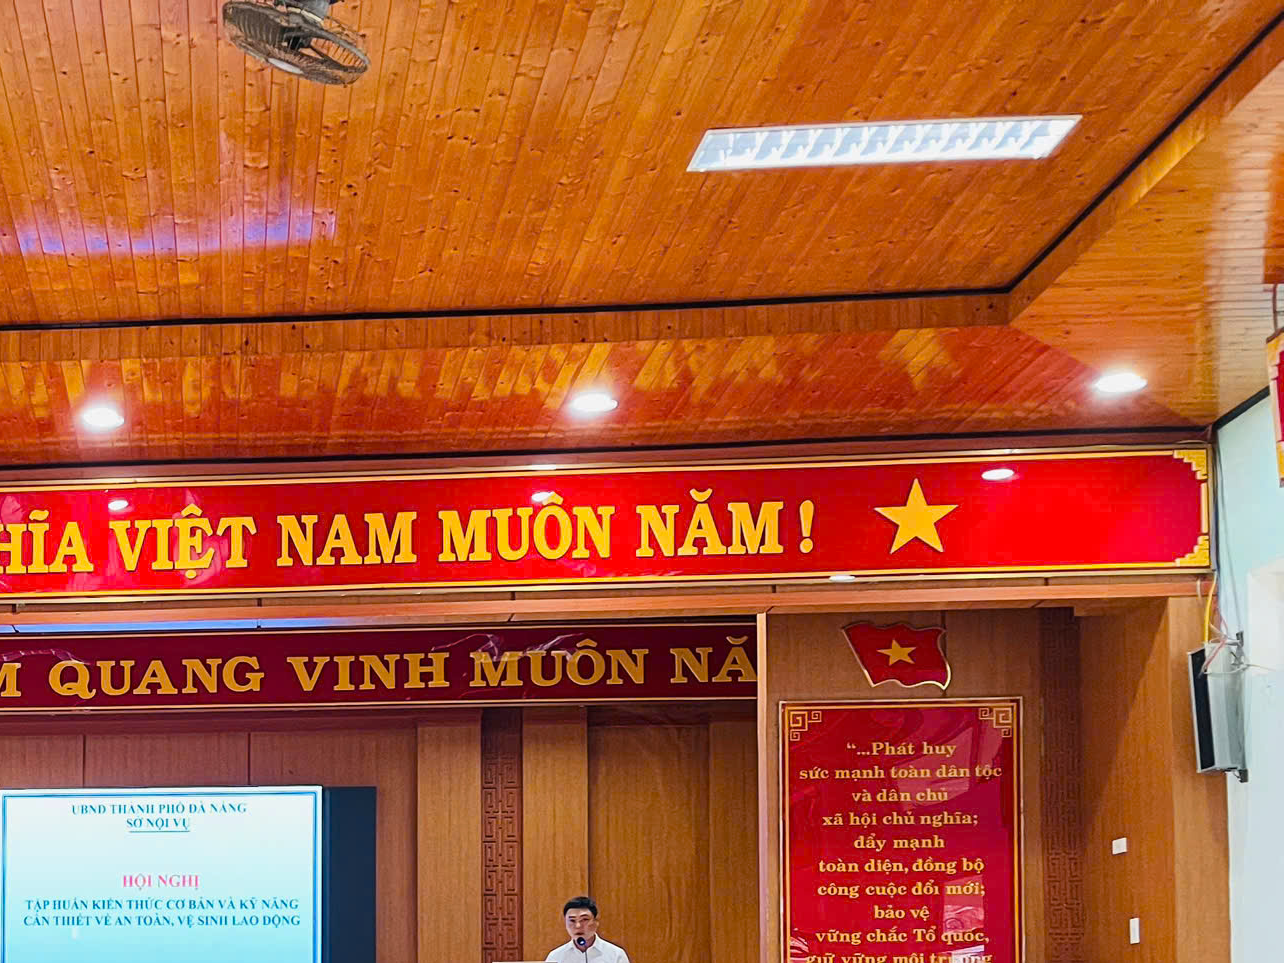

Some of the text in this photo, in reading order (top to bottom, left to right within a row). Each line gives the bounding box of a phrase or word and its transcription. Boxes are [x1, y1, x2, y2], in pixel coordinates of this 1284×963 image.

[109, 504, 257, 579] VIỆT
[276, 511, 418, 567] NAM
[438, 492, 616, 562] MUÔN
[48, 655, 265, 700] QUANG
[287, 650, 451, 692] VINH
[469, 638, 650, 687] MUÔN
[670, 635, 757, 684] NĂ
[922, 742, 956, 757] huy
[800, 765, 1002, 781] sức mạnh toàn dân tộc
[852, 788, 948, 802] và dân chủ
[72, 804, 106, 815] UBND
[126, 817, 189, 830] SỞ NỘI VỤ
[823, 812, 977, 828] xã hội chủ nghĩa;
[893, 835, 944, 850] mạnh
[819, 856, 984, 875] toàn diện, đồng bộ
[123, 872, 199, 890] HỘI NGHỊ
[817, 883, 860, 899] công
[865, 882, 907, 899] cuộc
[945, 881, 985, 896] mới;
[26, 900, 50, 912] TẬP
[126, 897, 162, 910] THỨC
[166, 899, 185, 910] CƠ
[218, 897, 235, 909] VÀ
[240, 897, 257, 910] KỸ
[262, 897, 298, 909] NĂNG
[874, 904, 929, 921] bảo vệ
[115, 916, 132, 926] AN
[135, 913, 174, 926] TOÀN,
[178, 914, 194, 928] VỆ
[197, 916, 228, 926] SINH
[232, 915, 259, 926] LAO
[263, 914, 300, 928] ĐỘNG
[816, 926, 936, 945] vững chắc Tổ
